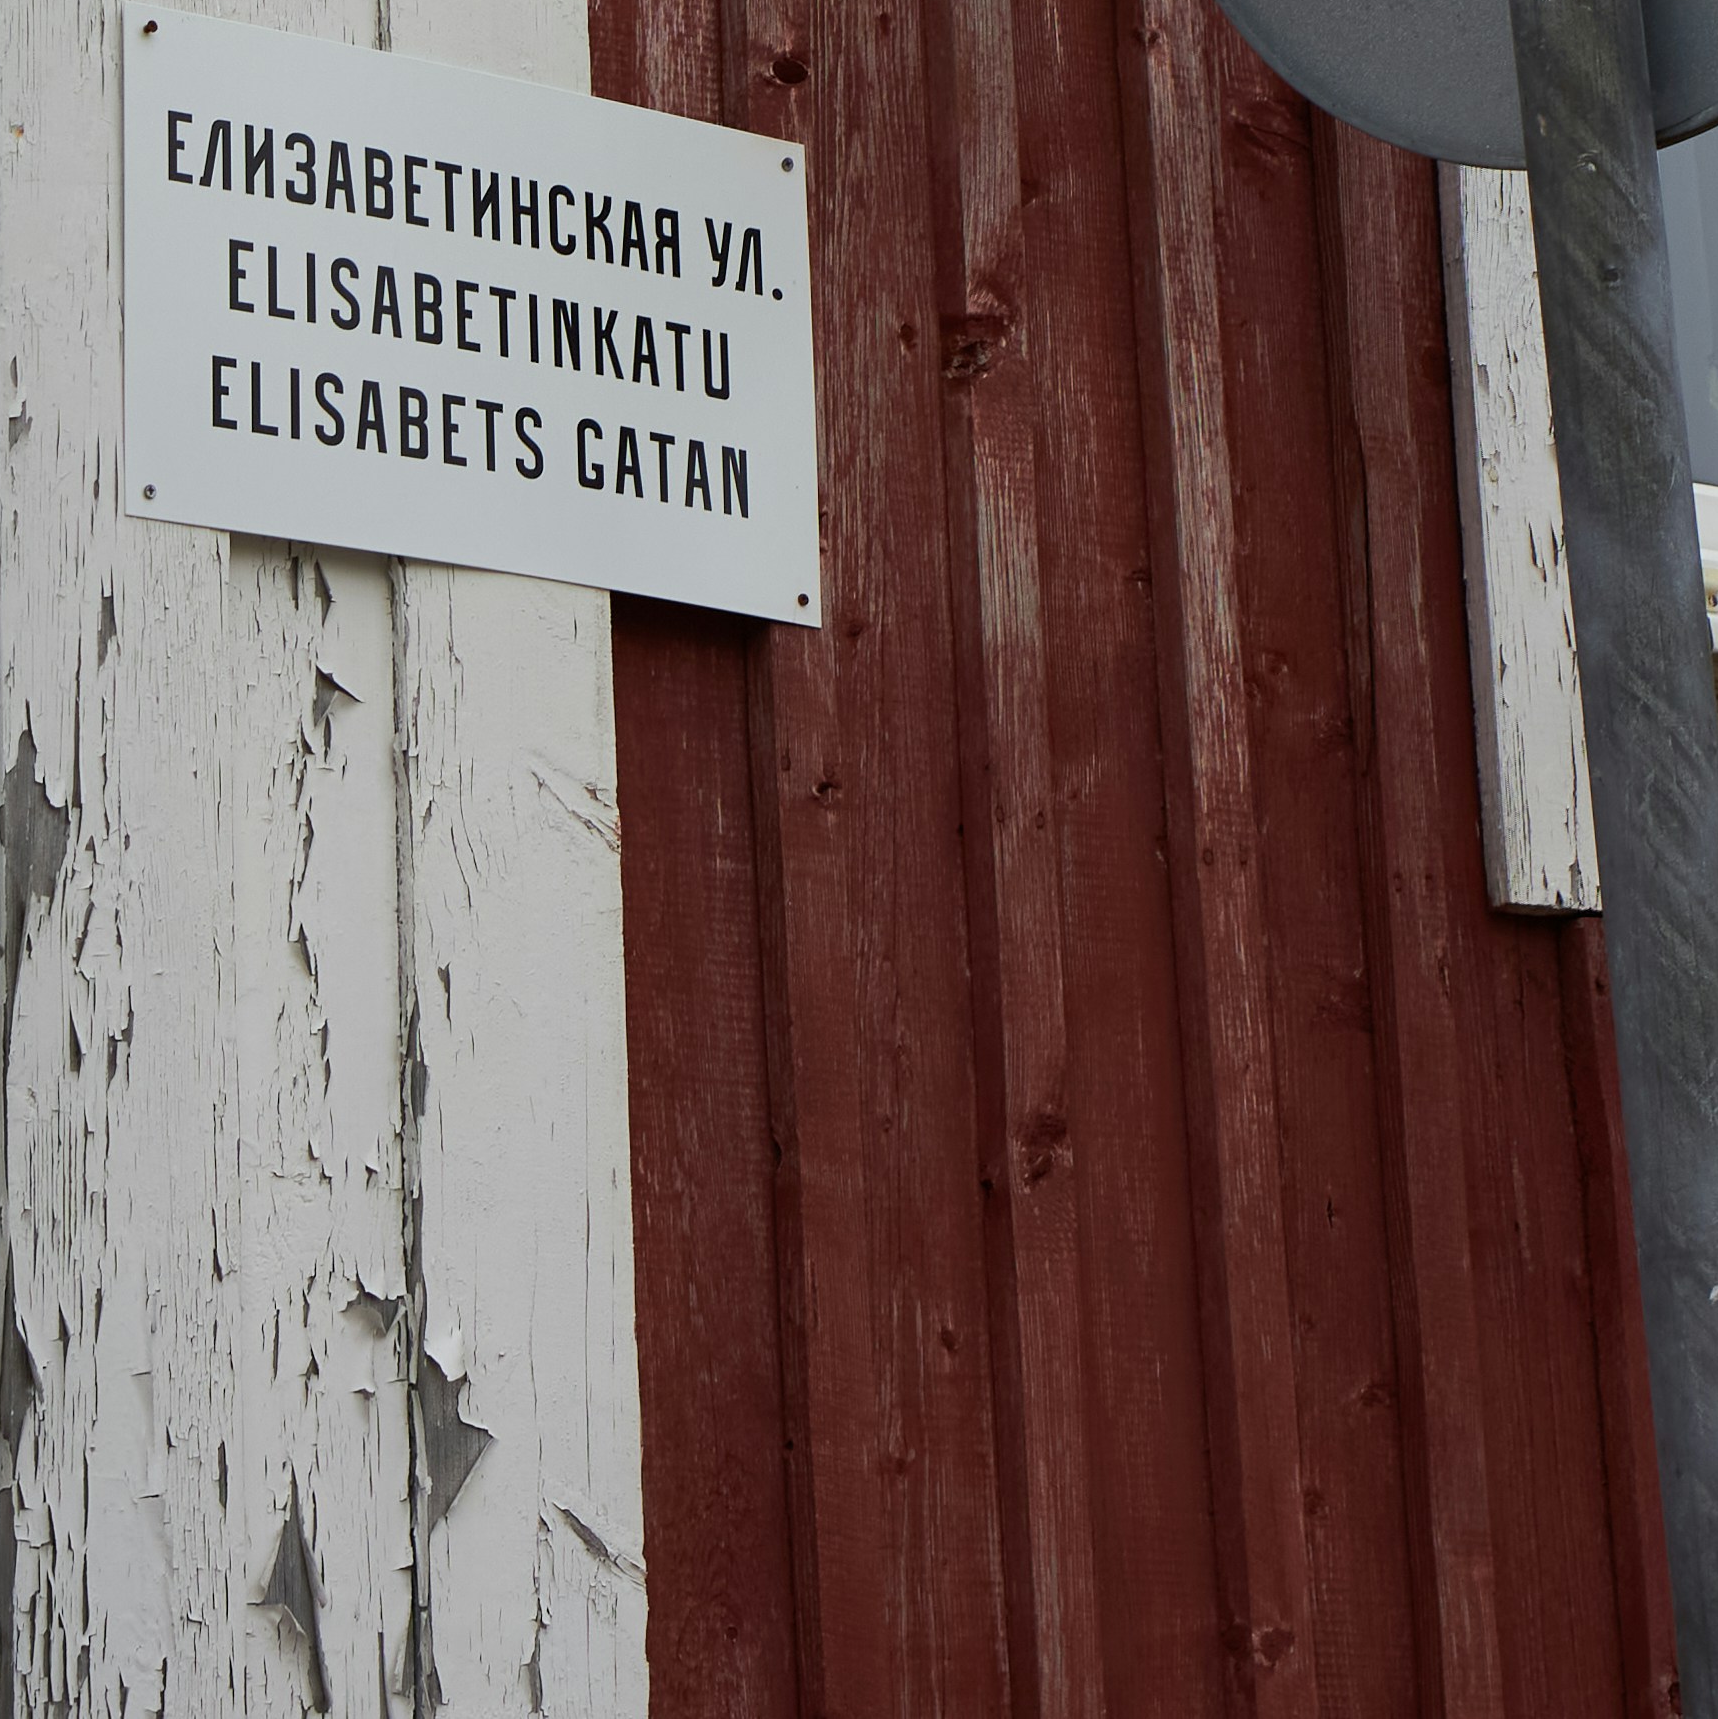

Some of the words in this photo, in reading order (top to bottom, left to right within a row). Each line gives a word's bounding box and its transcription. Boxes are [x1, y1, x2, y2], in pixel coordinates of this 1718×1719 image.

[167, 108, 681, 279] ЕЛИЗАВЕТИНСКАЯ
[704, 215, 784, 301] УЛ.
[228, 237, 731, 401] ELISABETINKATU
[212, 353, 544, 480] ELISABETS
[576, 417, 750, 519] GATAN
